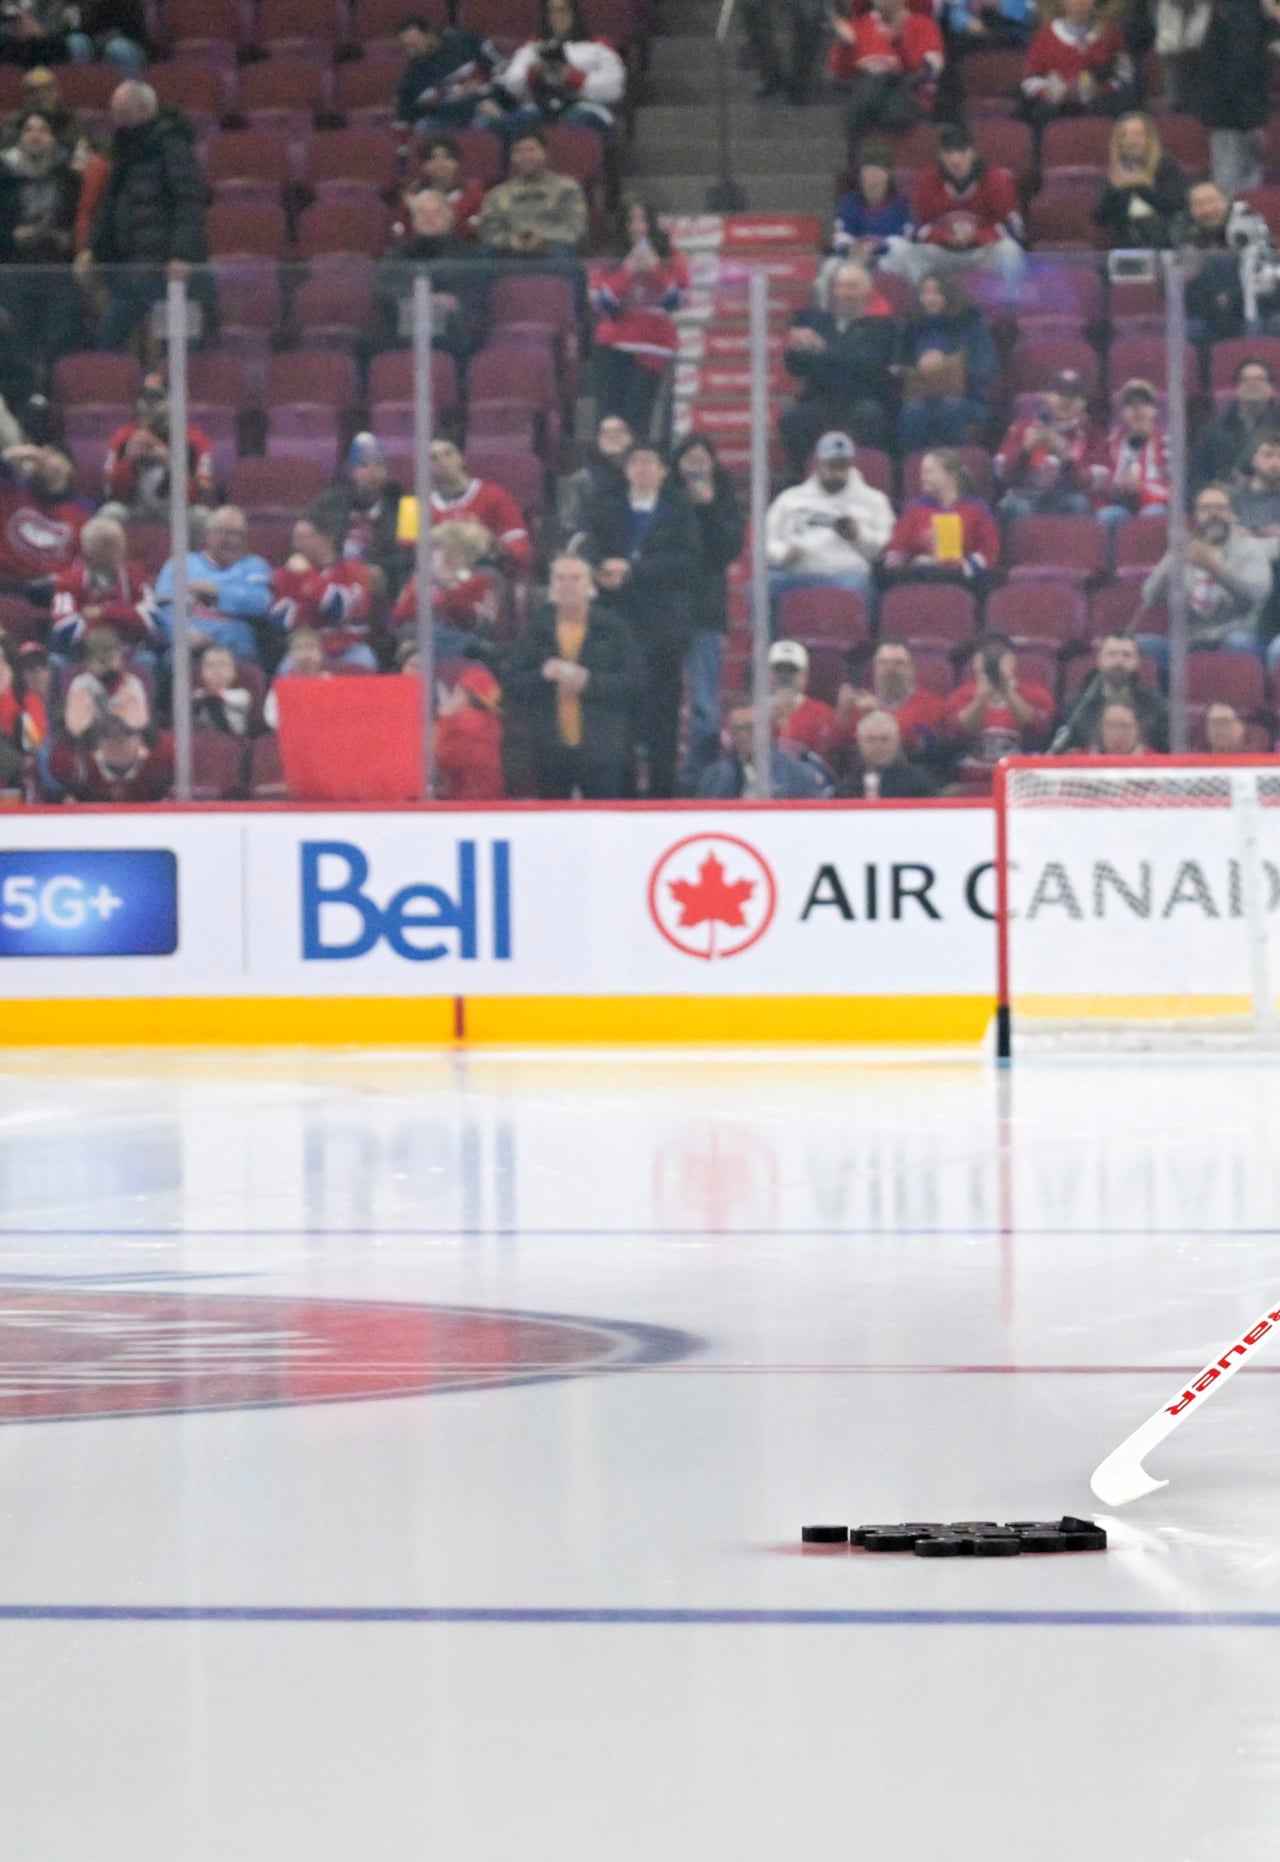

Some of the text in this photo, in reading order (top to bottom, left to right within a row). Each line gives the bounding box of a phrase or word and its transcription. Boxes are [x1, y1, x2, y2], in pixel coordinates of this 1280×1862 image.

[2, 876, 123, 931] 5G+
[300, 840, 512, 962] Bell
[801, 861, 943, 922] AIR
